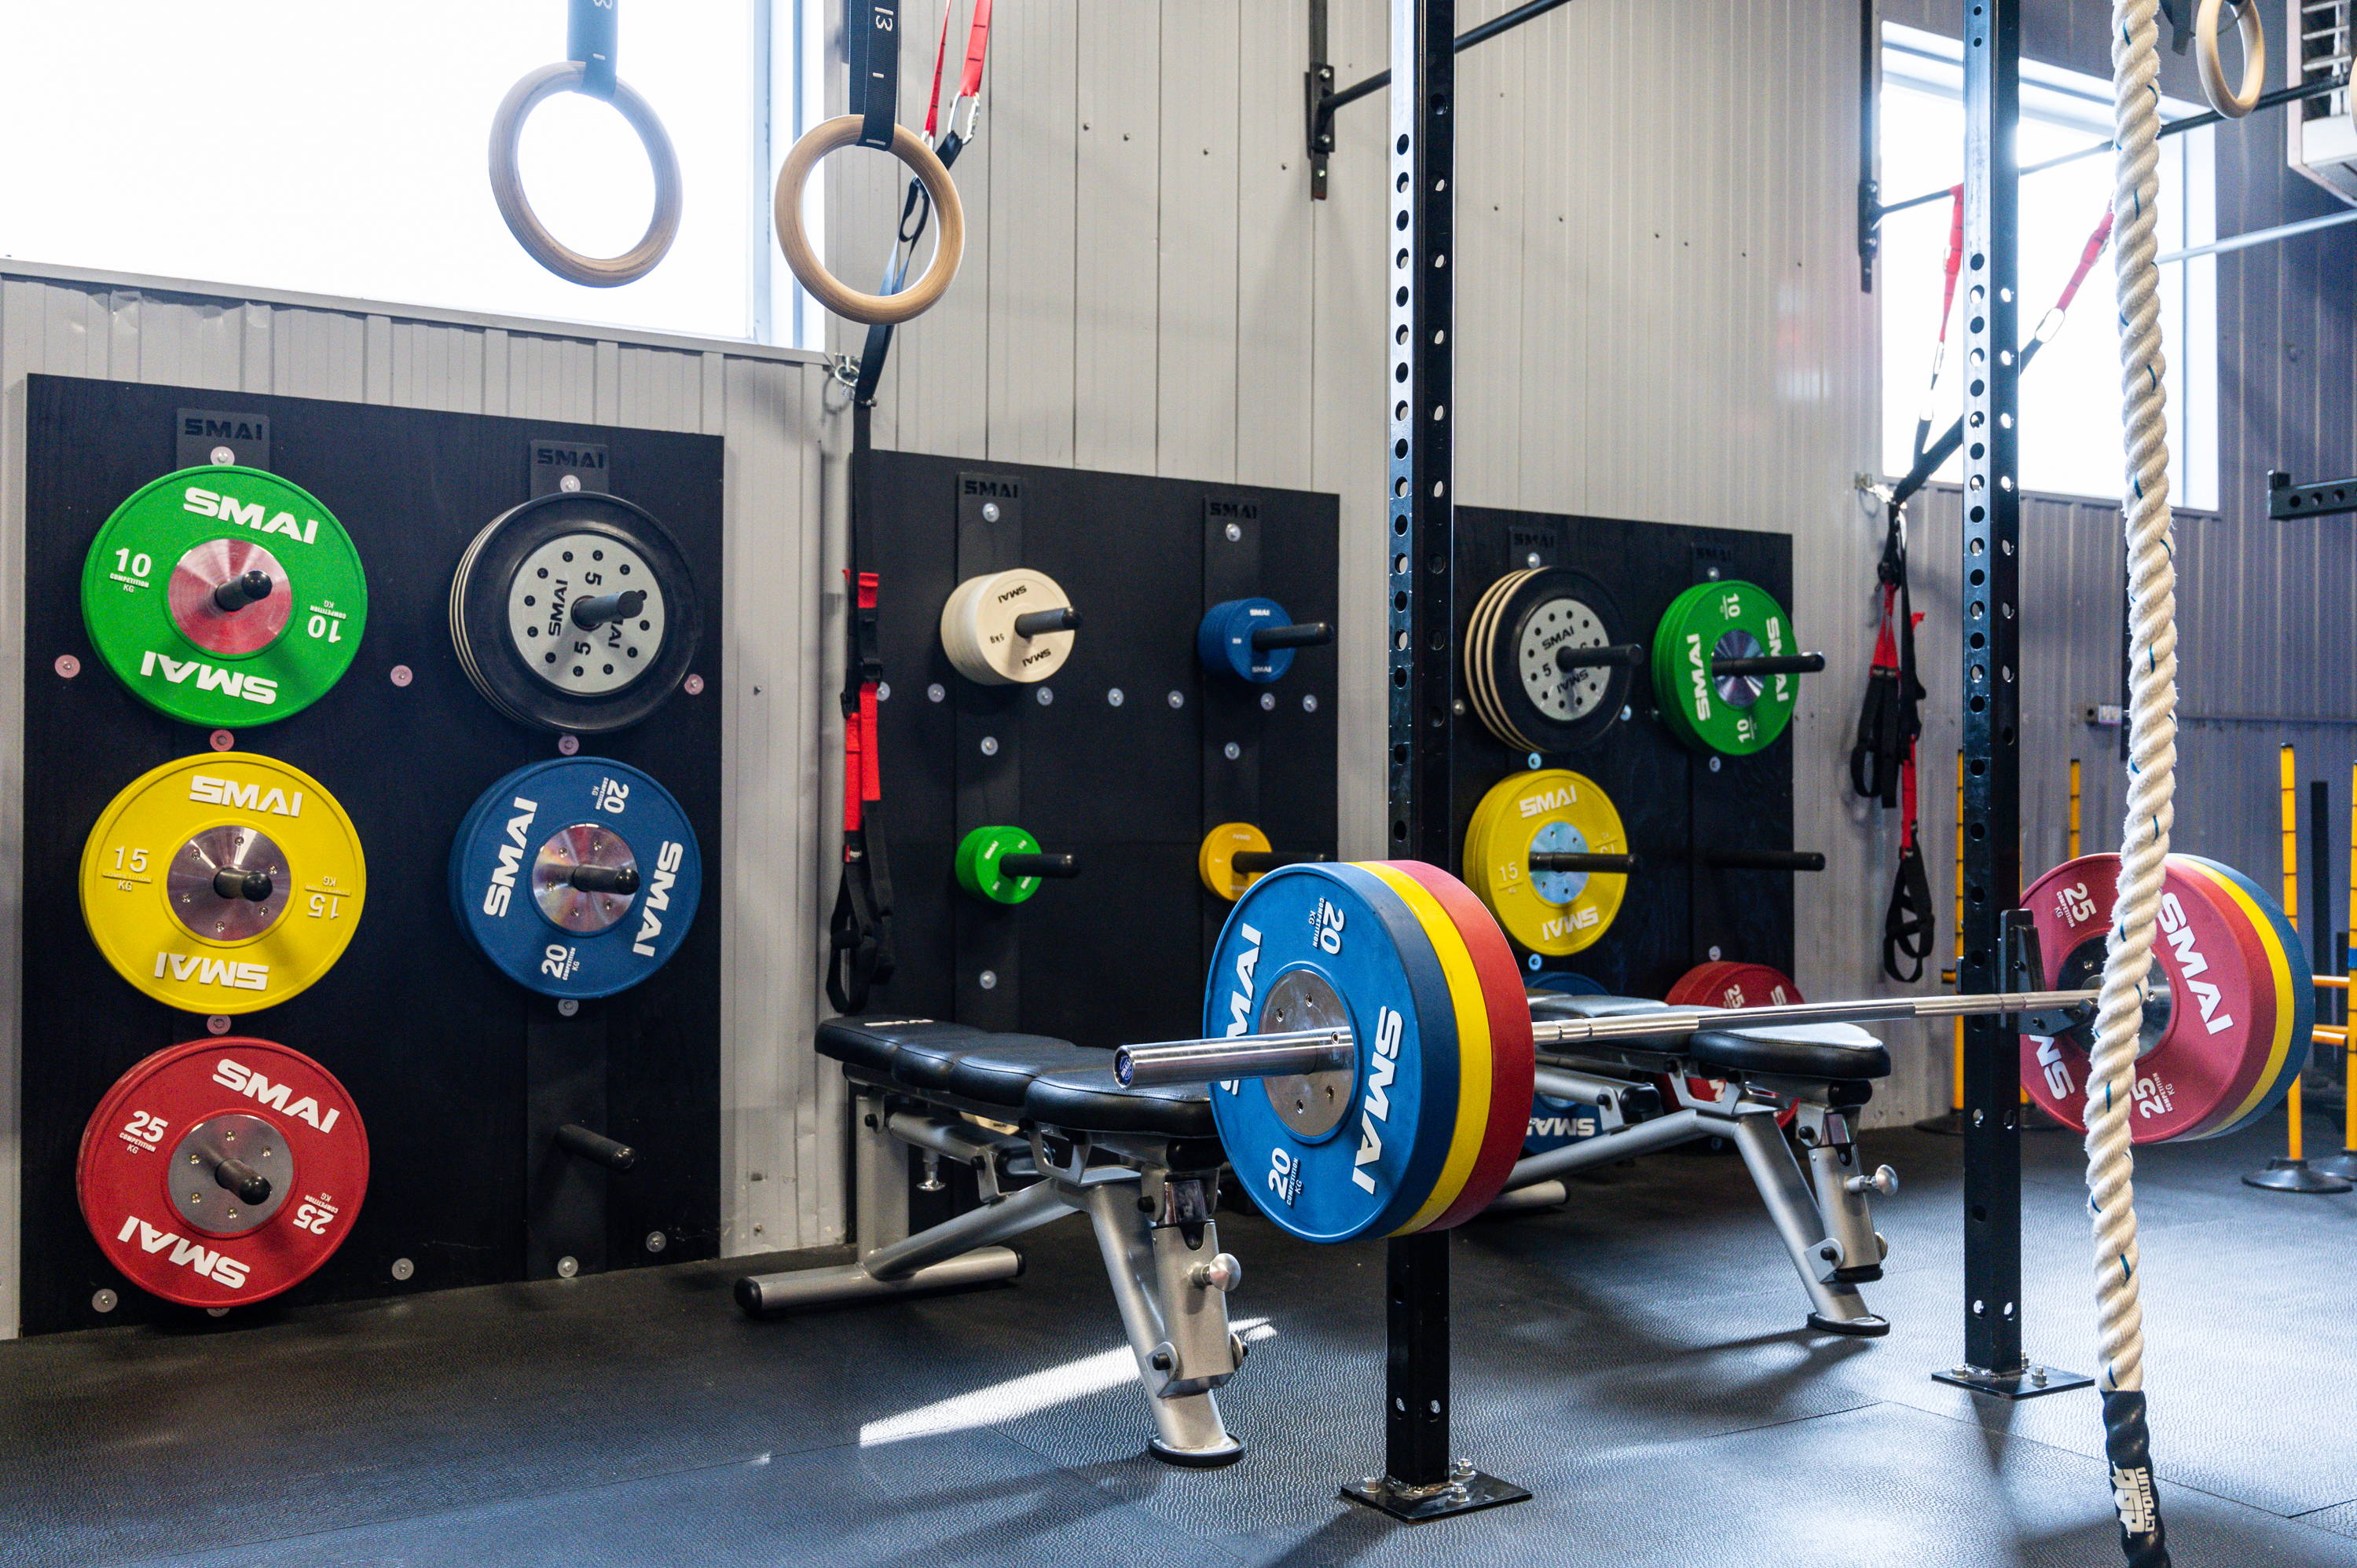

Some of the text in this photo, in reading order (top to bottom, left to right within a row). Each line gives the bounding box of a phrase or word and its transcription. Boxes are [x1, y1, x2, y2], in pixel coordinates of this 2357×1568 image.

[184, 418, 262, 441] SMAI
[537, 449, 604, 469] SMAI
[964, 480, 1018, 498] SMAI
[183, 487, 318, 544] SMAI
[1210, 502, 1257, 519] SMAI
[115, 548, 152, 577] 10
[109, 573, 149, 588] COMPETITION
[123, 584, 134, 593] KG
[585, 571, 603, 586] 5
[998, 584, 1027, 603] SMAI
[548, 579, 568, 636] SMAI
[1727, 592, 1741, 617] 10
[307, 615, 341, 643] 10
[1541, 625, 1574, 650] SMAI
[574, 641, 592, 656] 5
[1022, 648, 1051, 667] SMAI
[140, 650, 278, 705] SMAI
[1542, 663, 1552, 677] 5
[1556, 669, 1589, 694] SMAI
[1687, 633, 1710, 721] SMAI
[1736, 719, 1751, 743] 10
[189, 775, 303, 818] SMAI
[603, 779, 629, 814] 20
[1518, 785, 1577, 819] SMAI
[115, 846, 148, 873] 15
[482, 797, 538, 918] SMAI
[1499, 862, 1519, 881] 15
[118, 880, 132, 891] KG
[323, 876, 336, 887] KG
[307, 894, 339, 919] 15
[632, 841, 684, 957] SMAI
[2054, 906, 2064, 918] KG
[2056, 890, 2076, 929] COMPETITION
[2063, 882, 2098, 922] 25
[1308, 910, 1316, 925] KG
[1312, 897, 1325, 948] COMPETITION
[1322, 901, 1344, 954] 20
[1541, 906, 1600, 941] SMAI
[154, 952, 269, 991] SMAI
[541, 944, 568, 978] 20
[562, 947, 576, 980] COMPETITION
[571, 961, 580, 972] KG
[2157, 892, 2234, 1035] SMAI
[1220, 923, 1261, 1095] MAI
[2029, 1035, 2075, 1100] SM
[212, 1058, 340, 1134] SMAI
[1351, 1006, 1403, 1195] SMAI
[2131, 1077, 2166, 1119] 25
[2152, 1072, 2174, 1112] COMPETITION
[2165, 1083, 2176, 1096] KG
[124, 1111, 168, 1142] 25
[119, 1133, 156, 1152] COMPETITION
[126, 1144, 139, 1154] KG
[1268, 1148, 1291, 1200] 20
[1286, 1157, 1299, 1206] COMPETITION
[1294, 1179, 1303, 1194] KG
[292, 1204, 334, 1235] 25
[117, 1215, 251, 1289] SMAI
